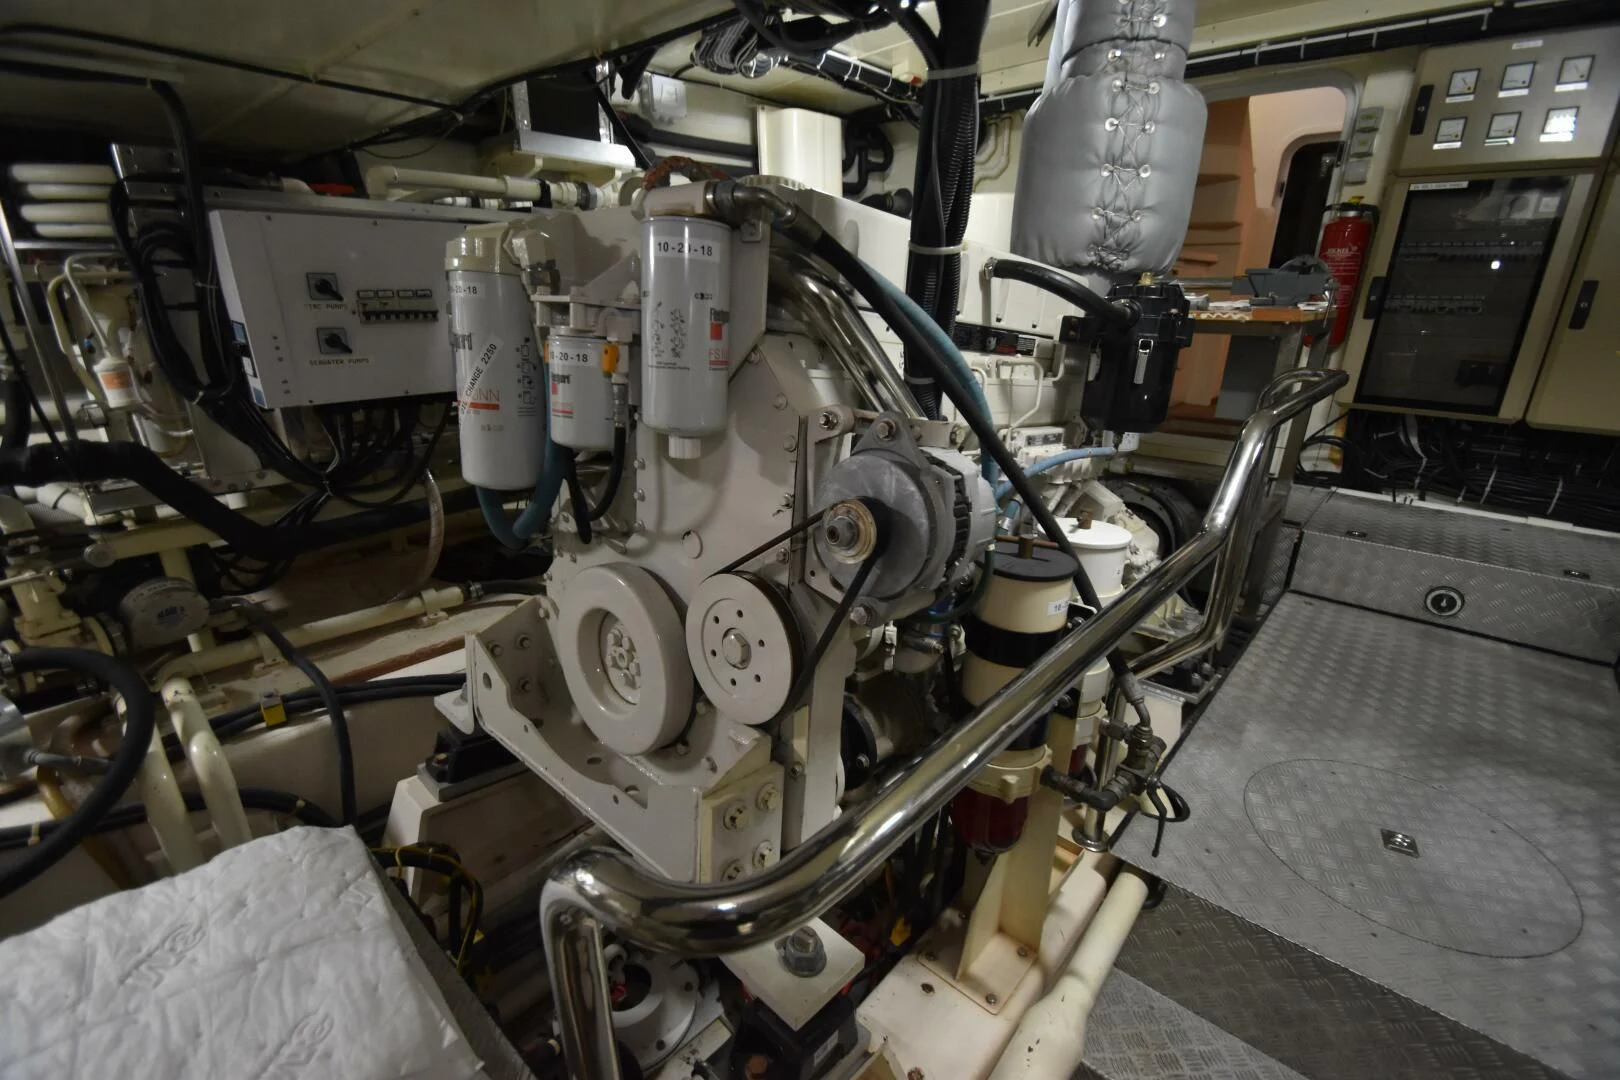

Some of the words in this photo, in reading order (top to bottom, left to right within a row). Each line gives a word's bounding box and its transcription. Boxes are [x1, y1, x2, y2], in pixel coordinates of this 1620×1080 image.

[657, 241, 712, 257] 10-20-18
[465, 366, 484, 397] CHANGE
[480, 343, 497, 365] 2250
